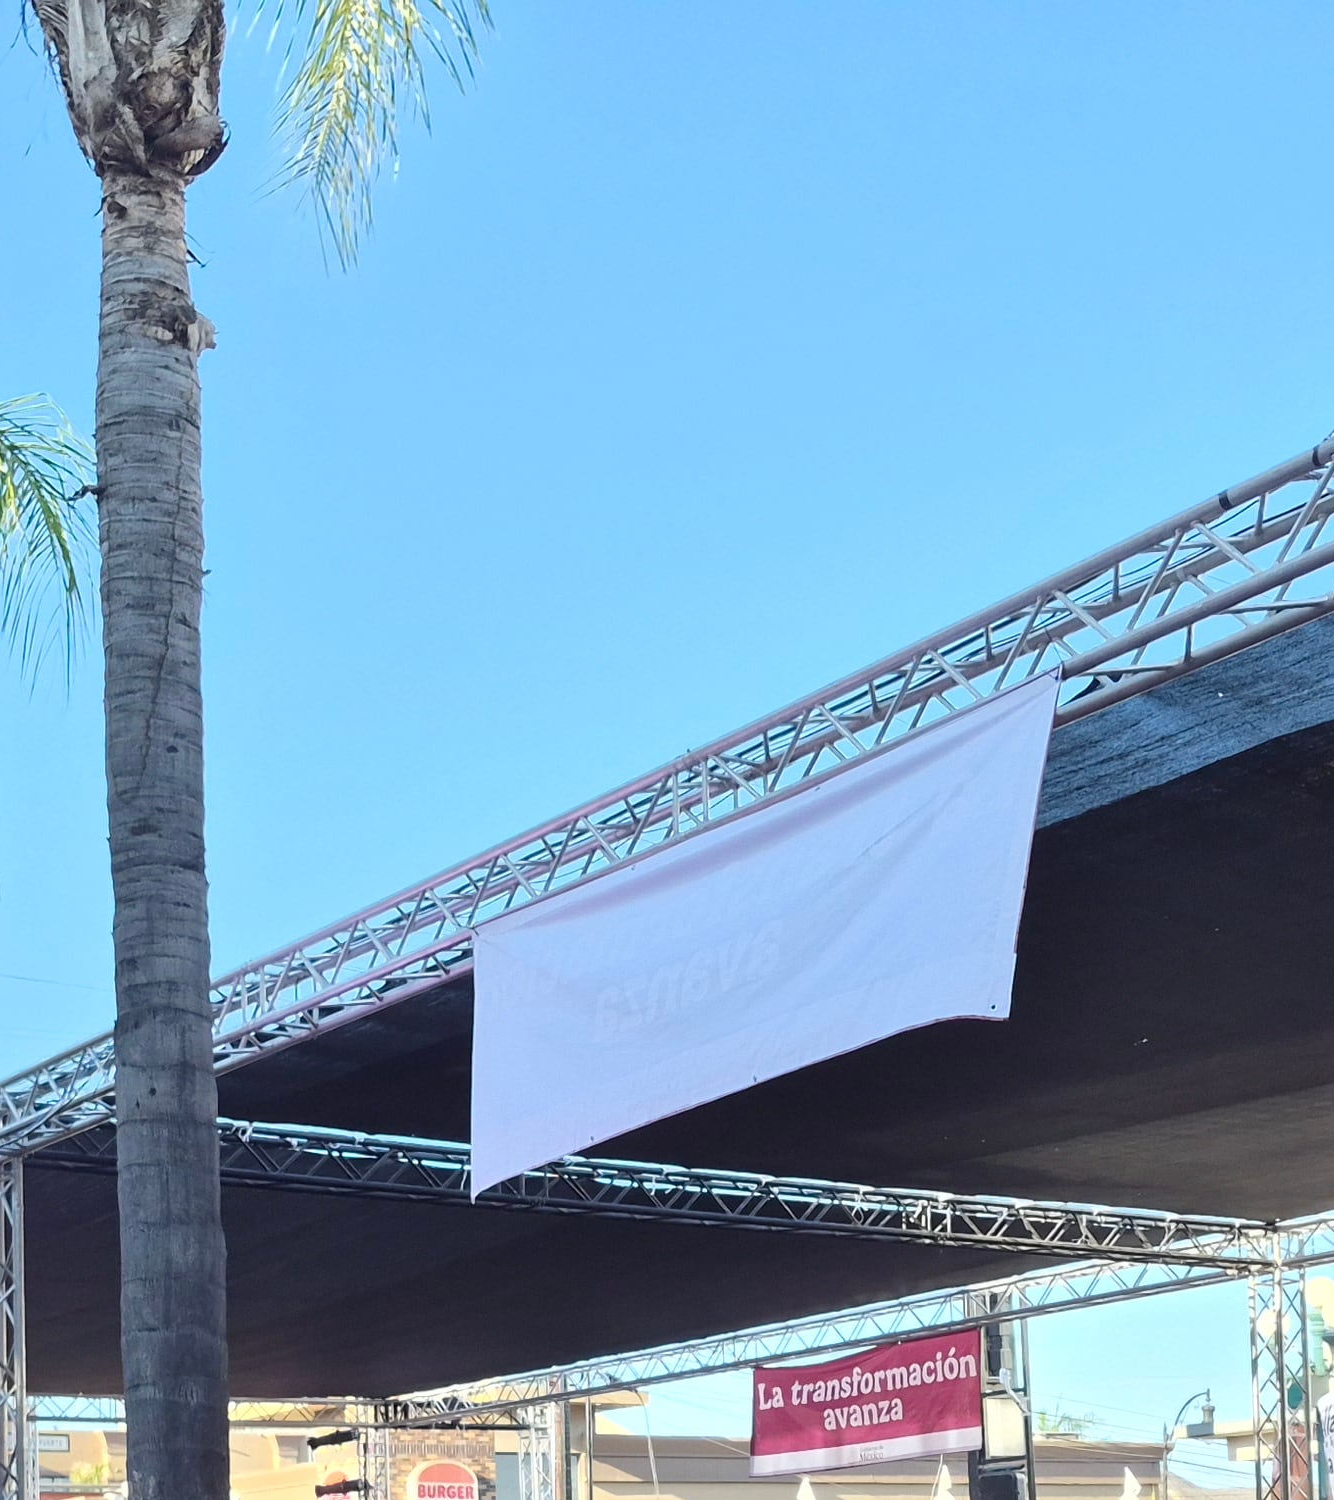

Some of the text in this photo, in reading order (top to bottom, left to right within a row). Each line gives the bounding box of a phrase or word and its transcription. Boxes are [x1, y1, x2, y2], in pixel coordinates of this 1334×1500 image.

[758, 1347, 978, 1412] La transformación
[823, 1397, 904, 1431] avanza
[417, 1484, 475, 1500] BURGER
